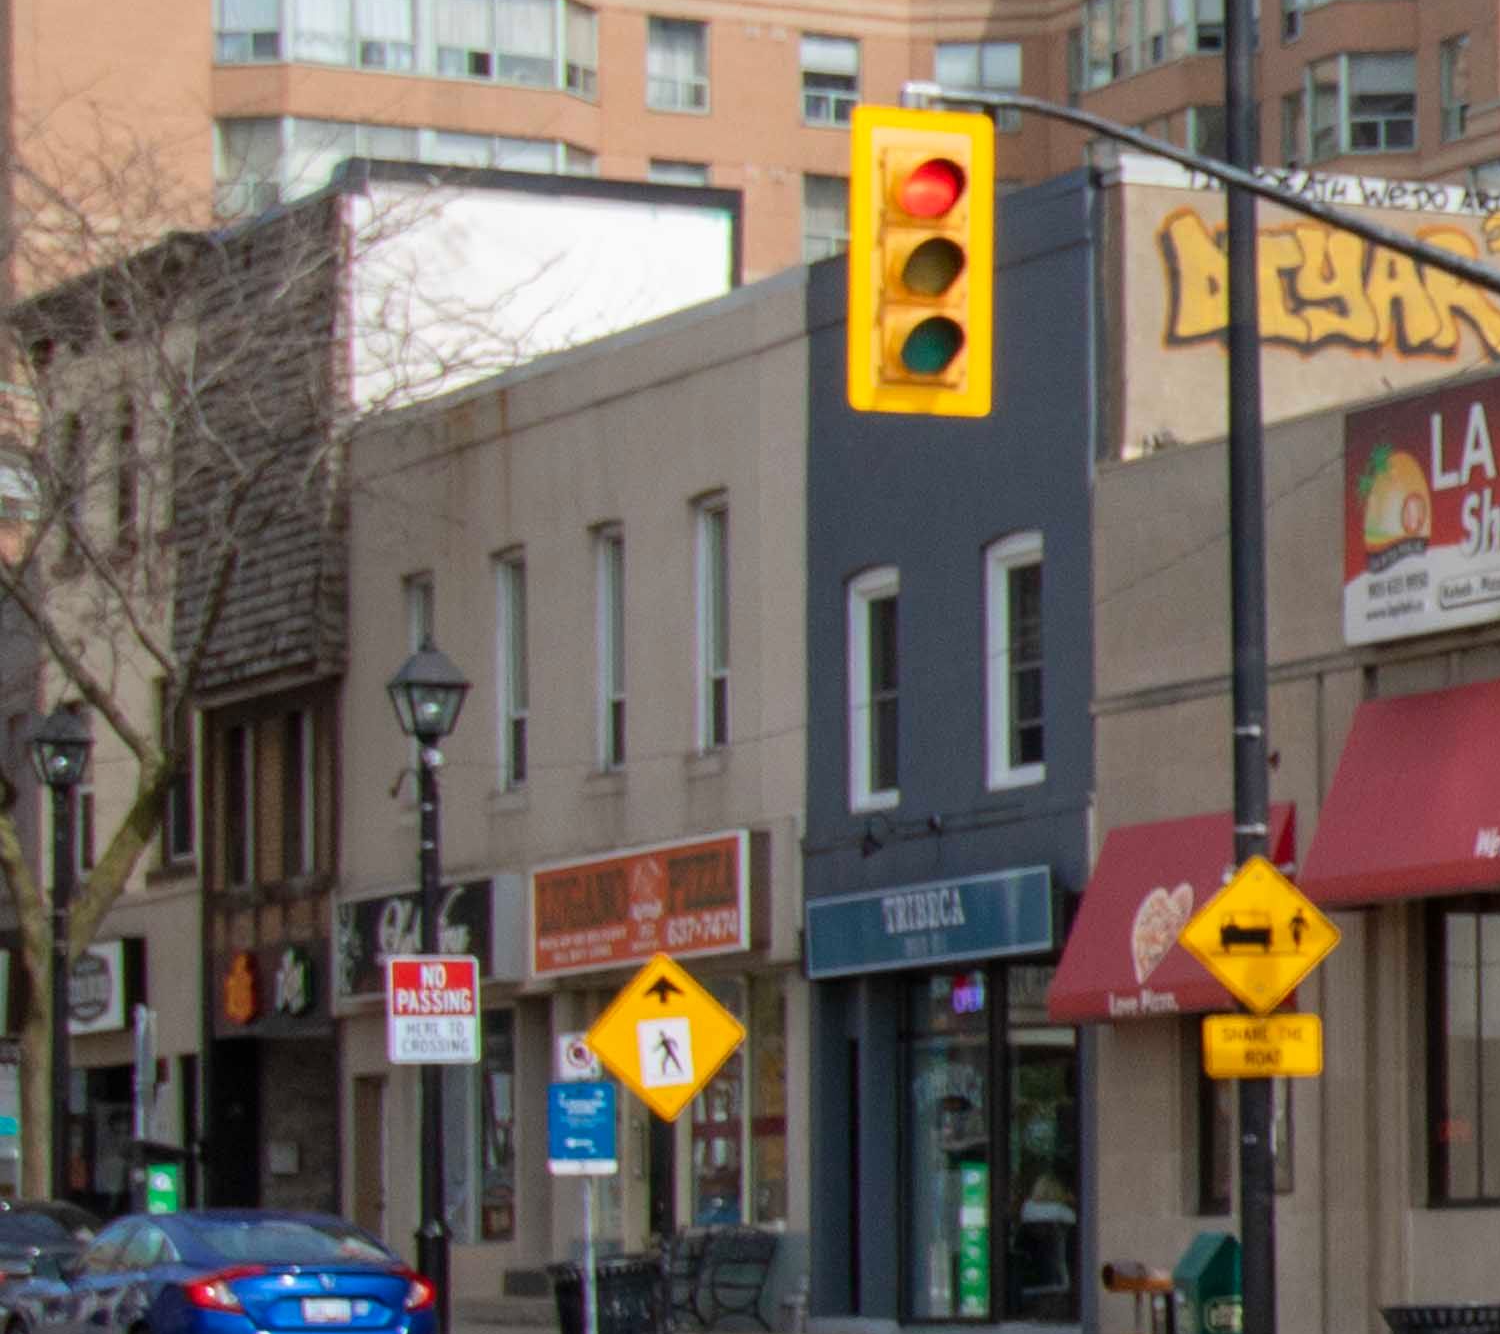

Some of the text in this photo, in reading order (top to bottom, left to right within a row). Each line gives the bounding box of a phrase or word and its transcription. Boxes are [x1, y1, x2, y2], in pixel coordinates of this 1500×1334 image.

[1429, 401, 1498, 492] LA
[1475, 825, 1500, 859] We
[881, 886, 966, 935] TRIBECA
[421, 963, 447, 988] NO
[396, 988, 473, 1014] PASSING
[406, 1020, 466, 1037] HERE TO
[1222, 1026, 1304, 1042] SHARE THE
[402, 1038, 470, 1053] CROSSING
[1244, 1048, 1283, 1067] ROAD
